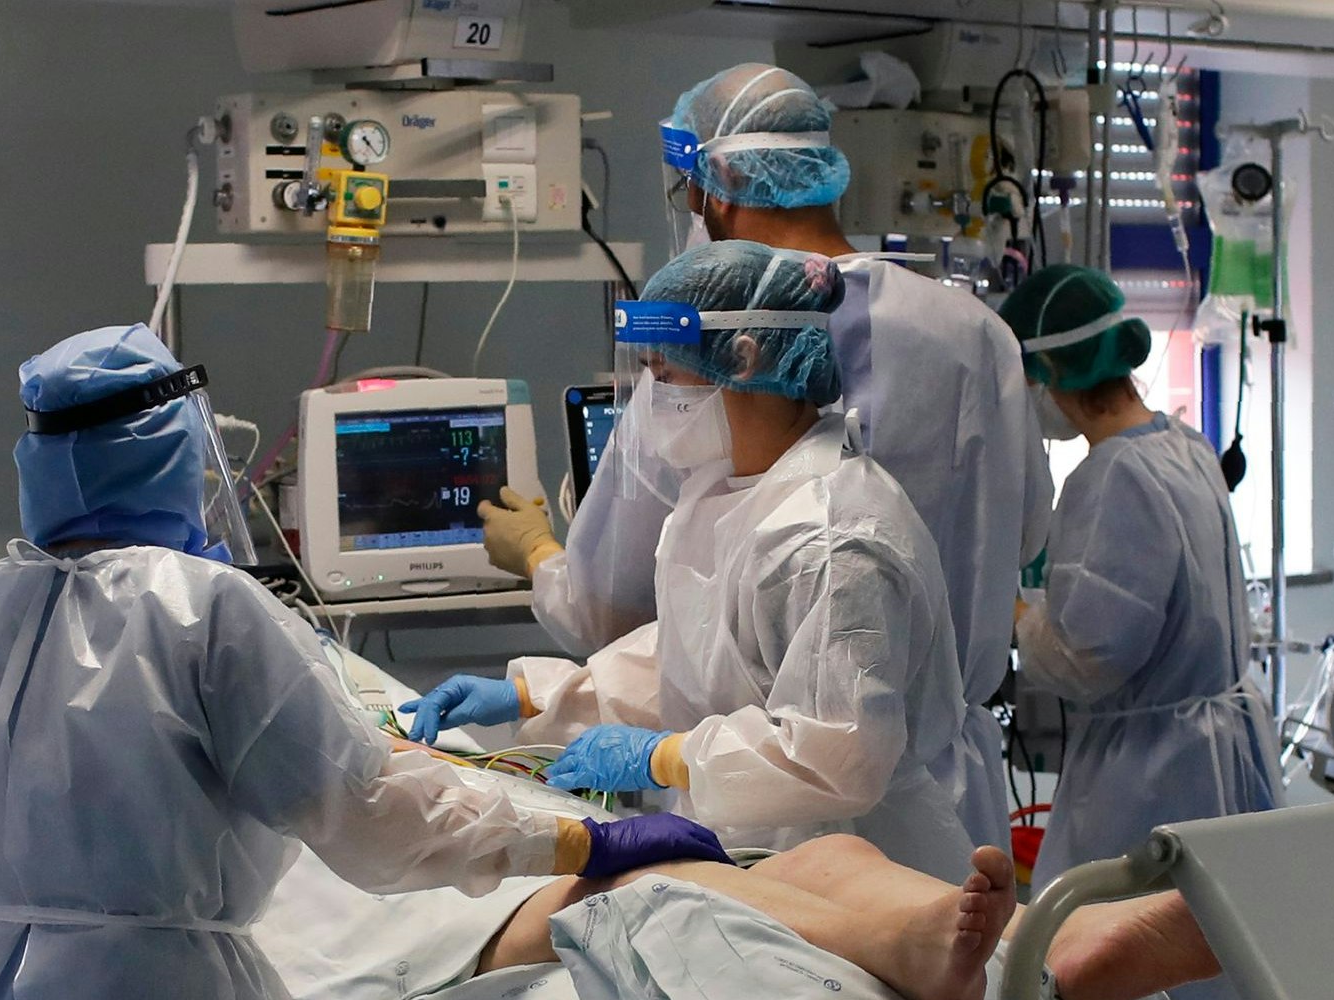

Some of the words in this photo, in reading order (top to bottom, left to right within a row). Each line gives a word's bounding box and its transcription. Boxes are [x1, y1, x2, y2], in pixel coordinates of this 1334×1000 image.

[465, 22, 492, 45] 20
[451, 430, 474, 447] 113
[452, 486, 471, 506] 19
[409, 561, 445, 572] PHILIPS
